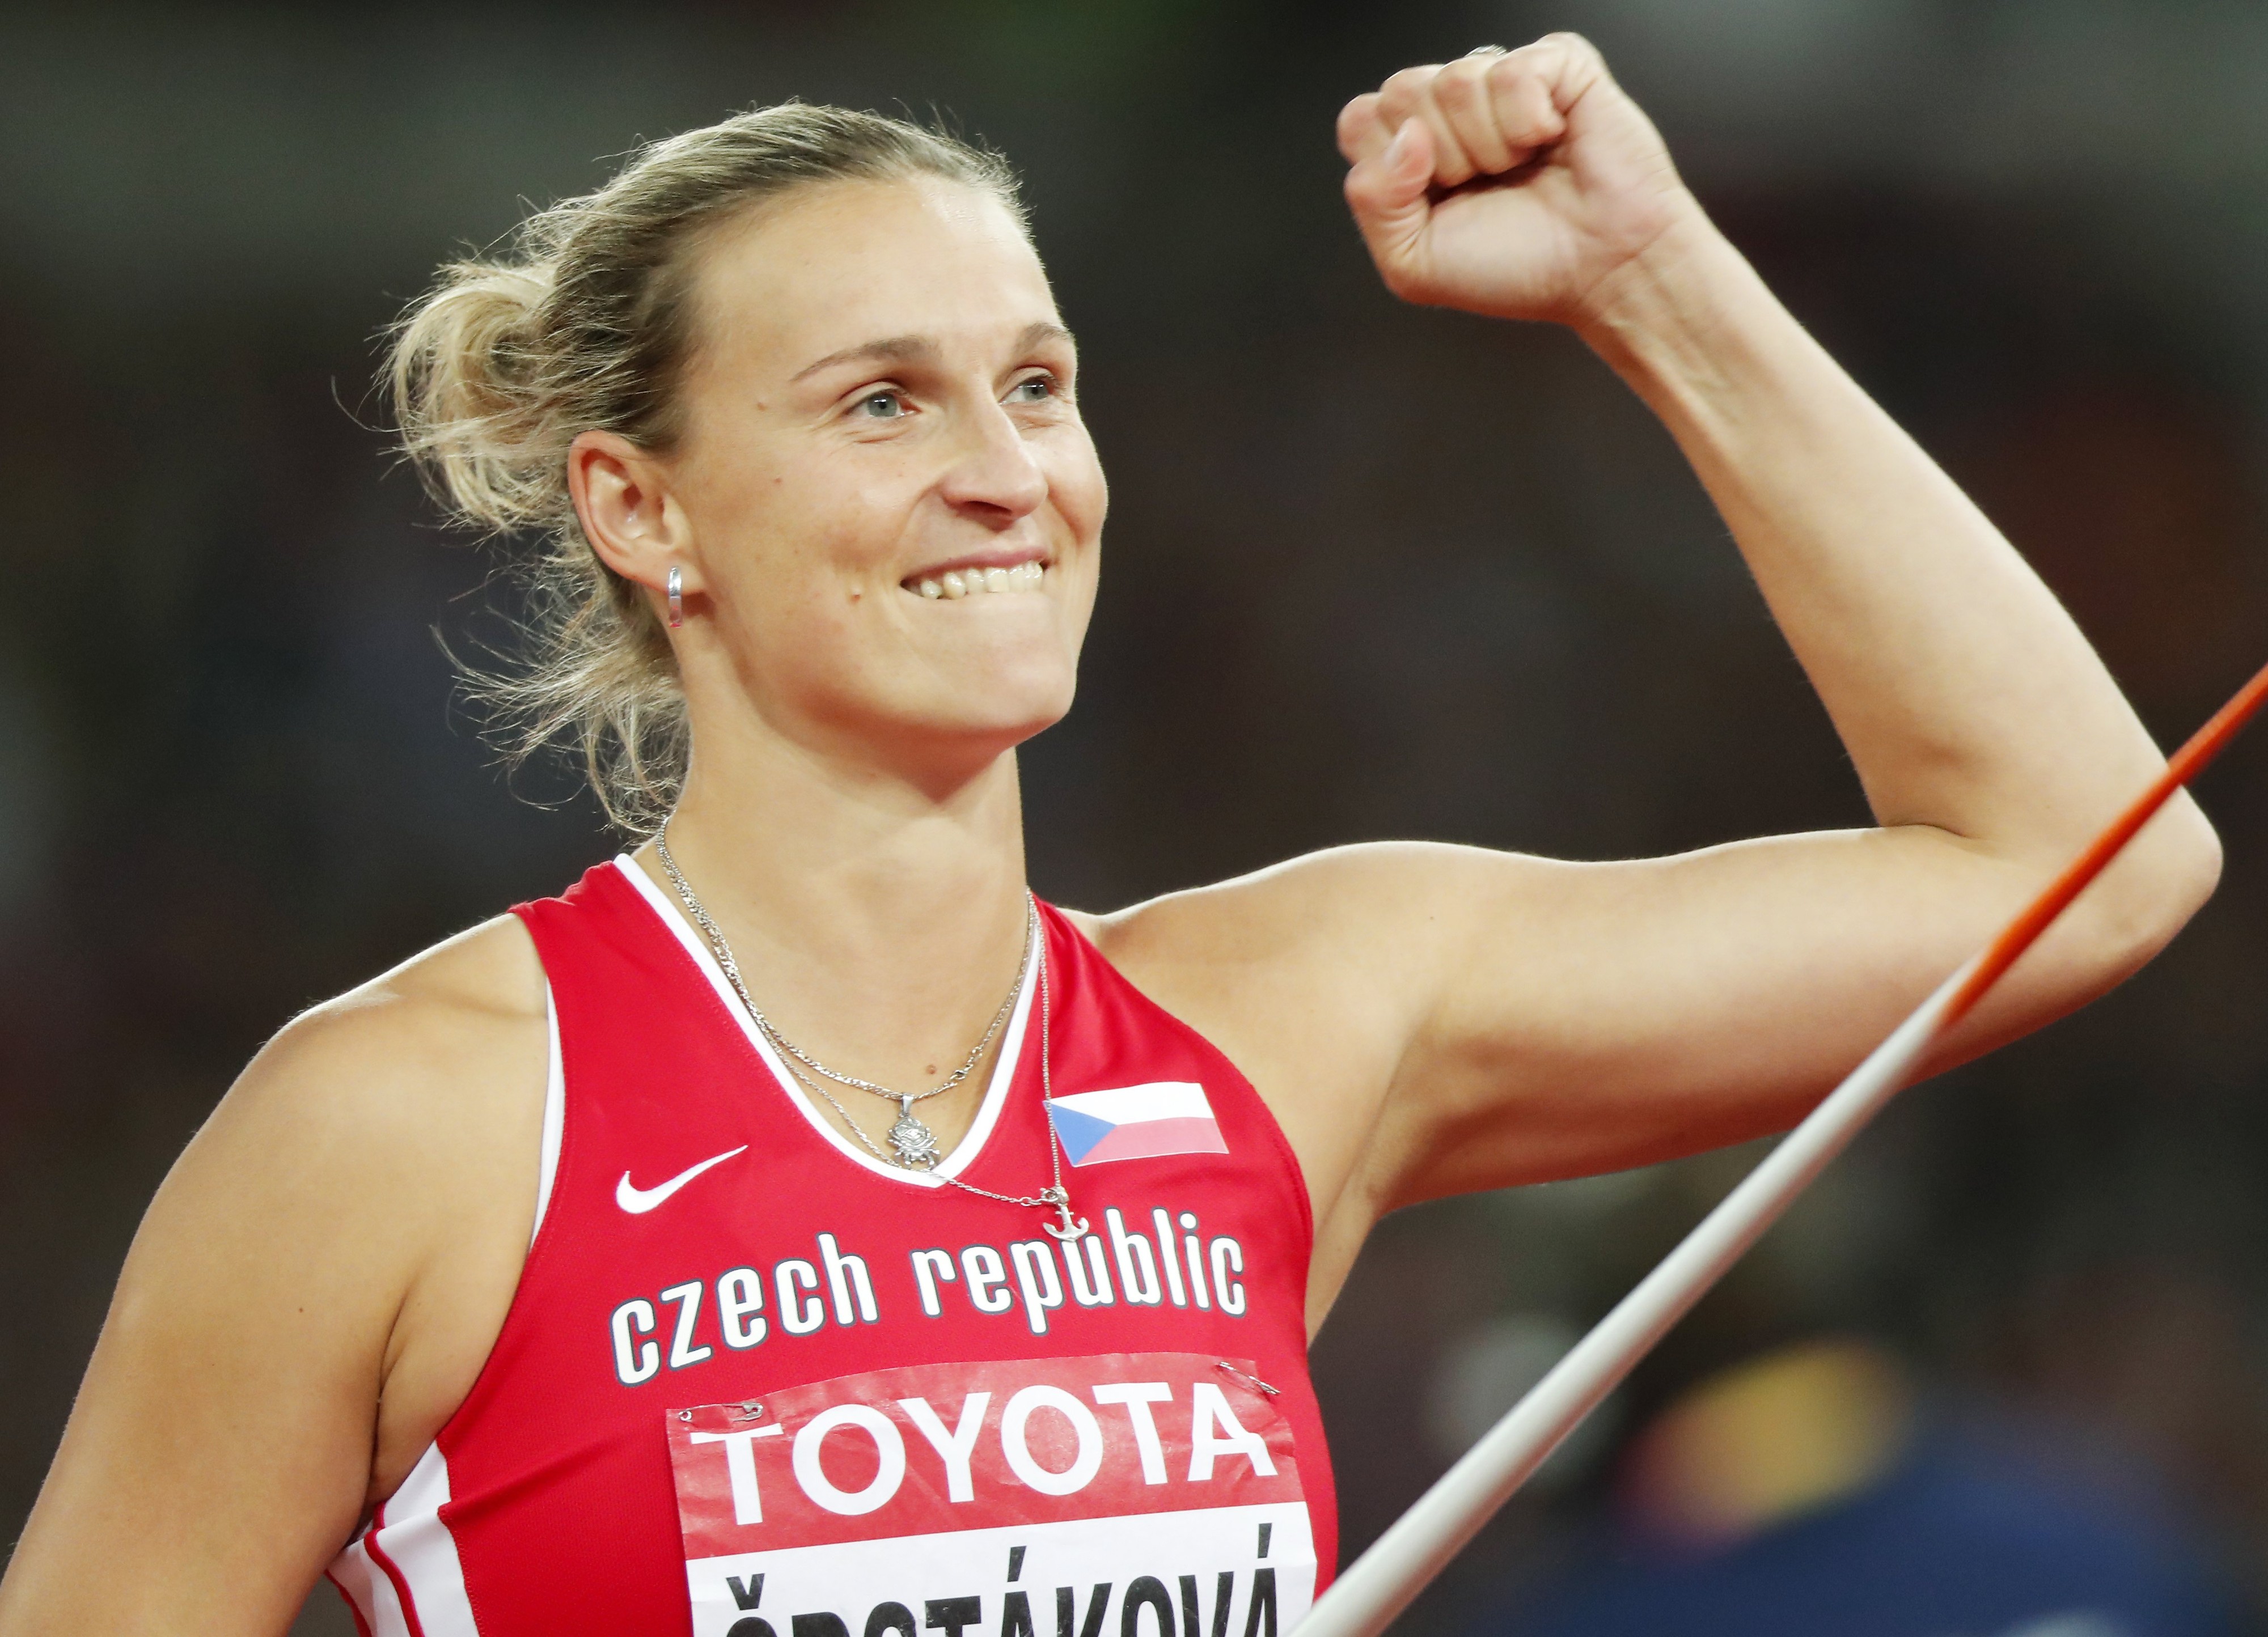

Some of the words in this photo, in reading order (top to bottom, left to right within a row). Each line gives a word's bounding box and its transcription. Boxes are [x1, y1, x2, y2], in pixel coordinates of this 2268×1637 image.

[609, 1231, 881, 1386] czech
[908, 1206, 1249, 1339] republic
[690, 1382, 1278, 1525] TOYOTA
